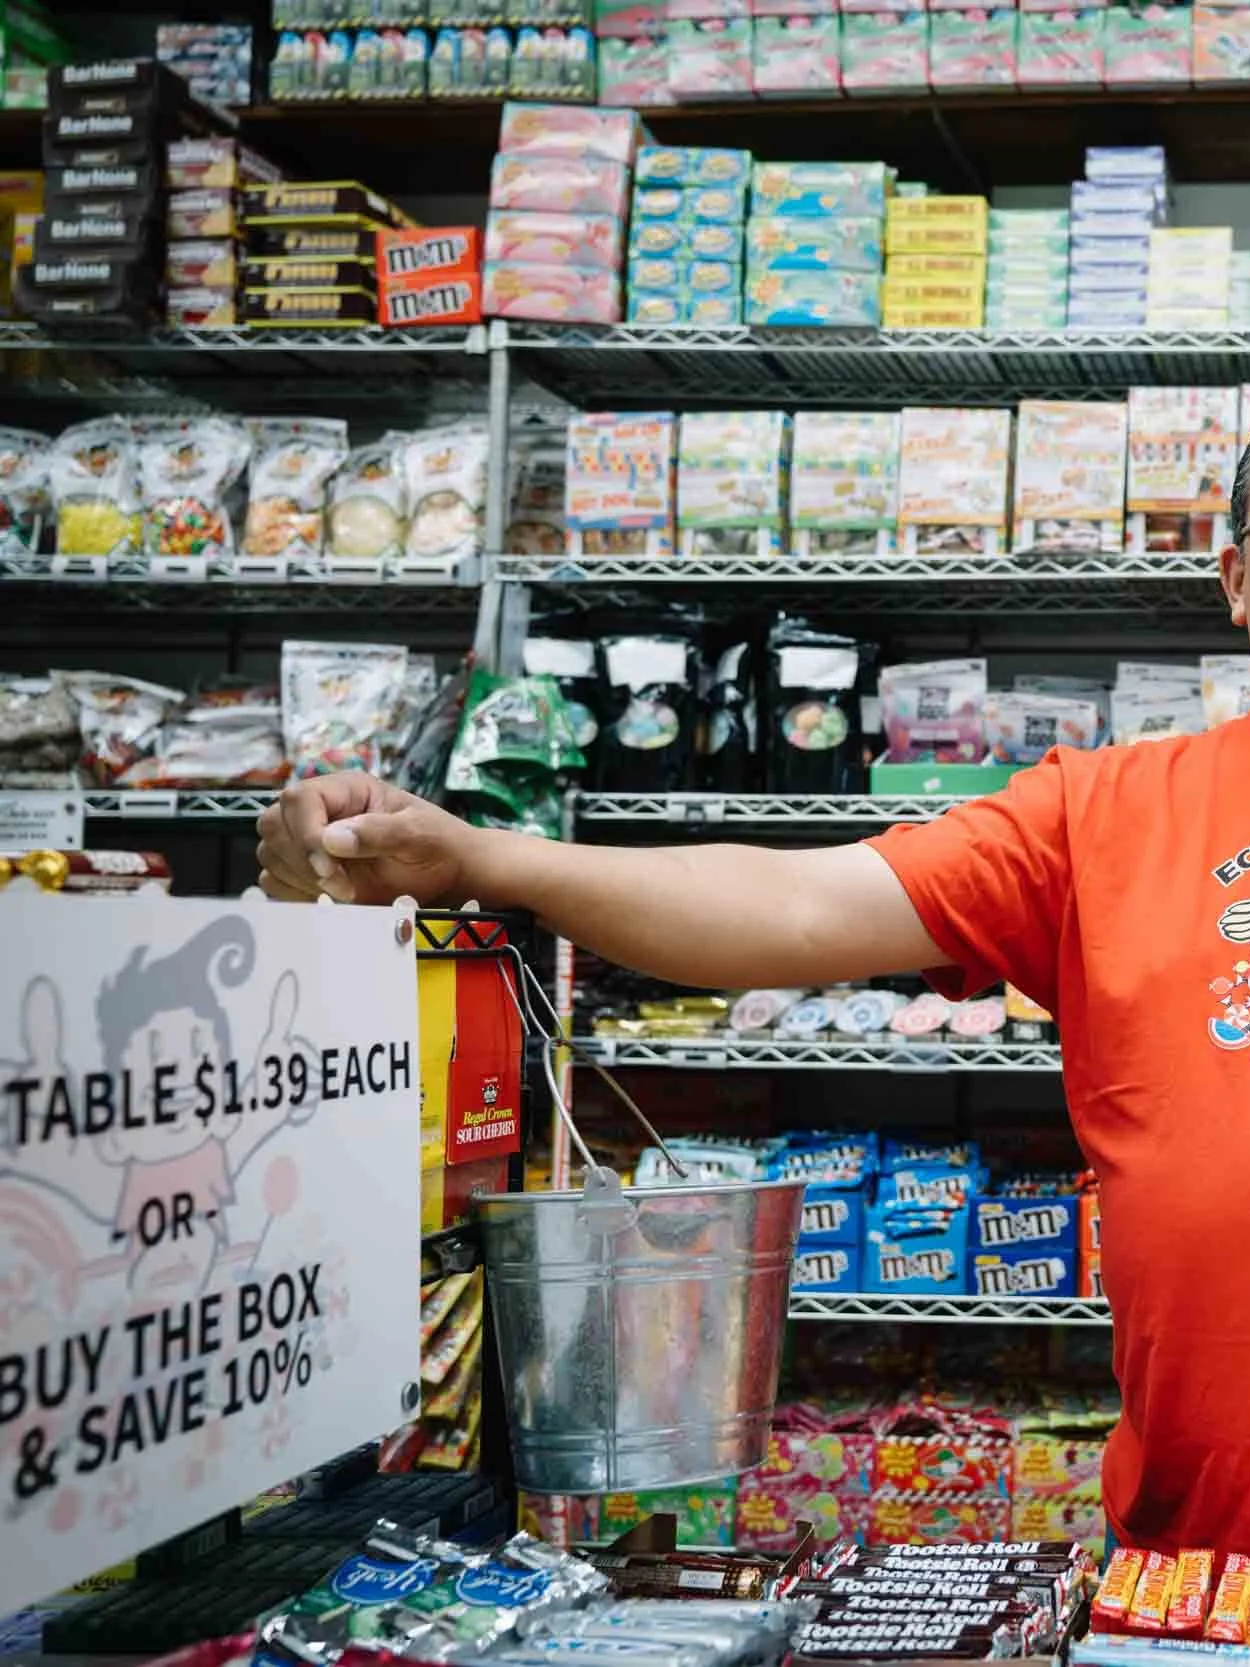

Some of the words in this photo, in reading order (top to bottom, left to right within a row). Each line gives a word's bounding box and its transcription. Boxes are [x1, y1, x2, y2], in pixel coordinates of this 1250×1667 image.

[4, 1063, 177, 1146] TABLE
[195, 1052, 308, 1126] $1.39
[322, 1041, 411, 1101] EACH
[463, 1107, 487, 1126] Regal
[456, 1126, 482, 1145] SOUR
[482, 1120, 517, 1140] CHERRY
[138, 1194, 195, 1246] OR
[0, 1326, 110, 1424] BUY
[125, 1293, 222, 1380] THE
[239, 1264, 321, 1338] BOX
[15, 1427, 57, 1499] &
[77, 1370, 205, 1473] SAVE
[223, 1332, 311, 1418] 10%
[889, 1543, 980, 1556] Tootsie
[983, 1542, 1041, 1554] Roll
[884, 1557, 960, 1571] Tootsie
[961, 1558, 1009, 1572] Roll
[864, 1567, 948, 1582] Tootsie
[950, 1572, 990, 1584] Roll
[830, 1577, 927, 1594] Tootsie
[929, 1582, 990, 1597] Roll
[848, 1597, 946, 1612] Tootsie
[949, 1599, 1009, 1613] Roll
[828, 1611, 930, 1623] Tootsie
[932, 1613, 994, 1625] Roll
[801, 1623, 903, 1639] Tootsie
[904, 1623, 966, 1638] Roll
